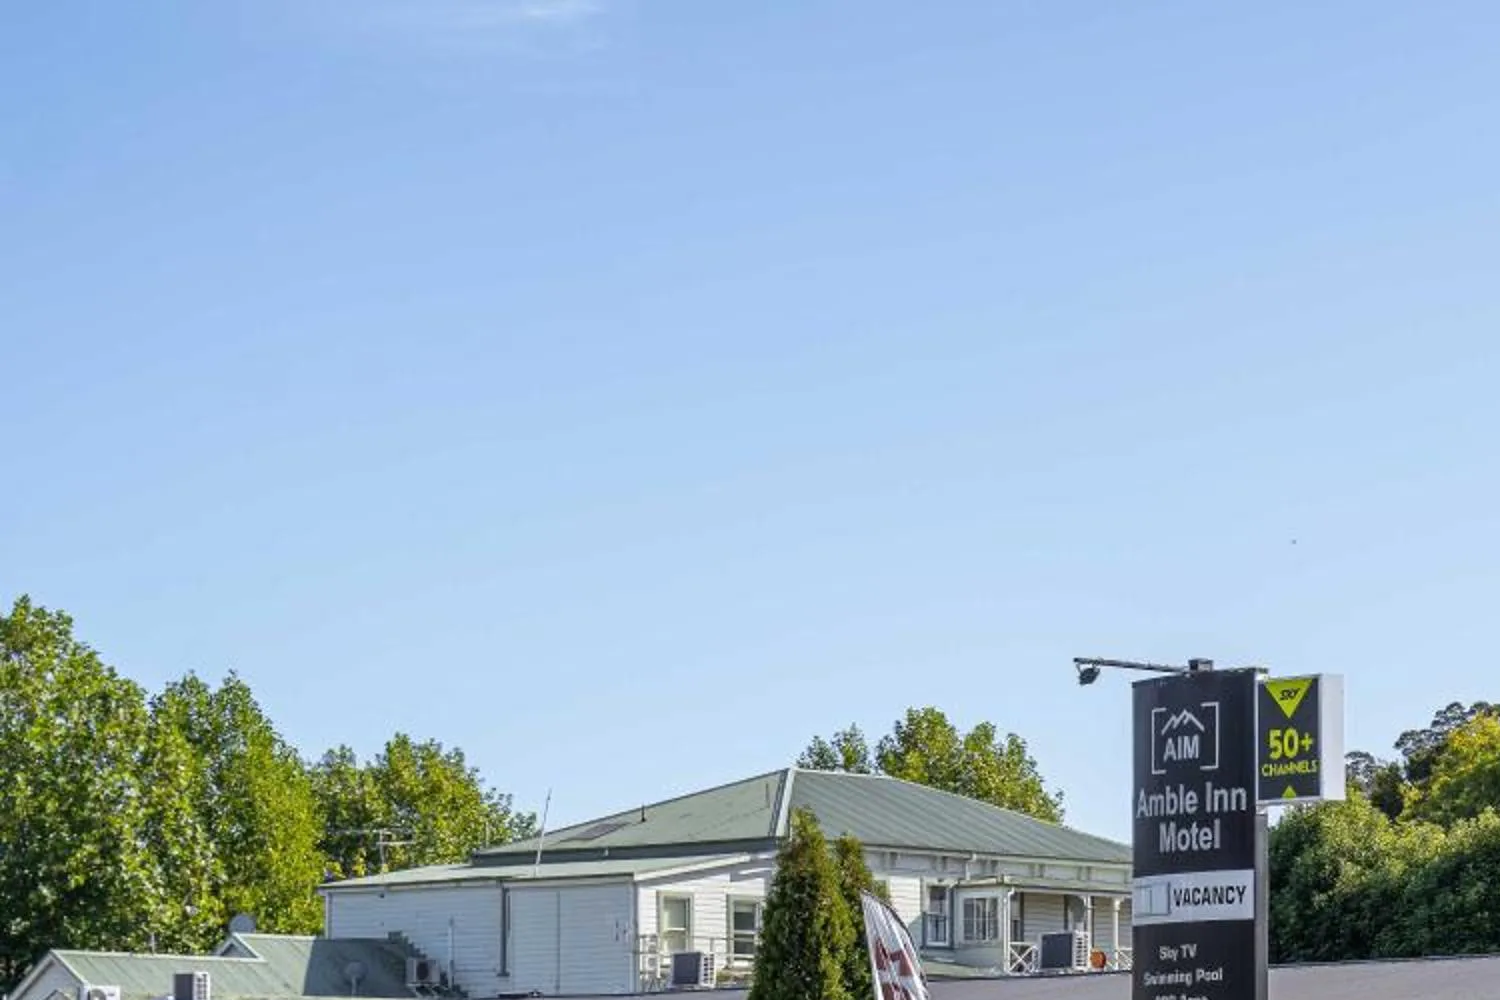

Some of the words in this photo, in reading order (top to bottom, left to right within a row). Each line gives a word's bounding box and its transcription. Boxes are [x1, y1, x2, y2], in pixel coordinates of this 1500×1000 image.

[1164, 735, 1199, 761] AIM
[1269, 728, 1313, 759] 50+
[1262, 760, 1317, 777] CHANNELS
[1136, 784, 1199, 818] Amble
[1205, 782, 1247, 812] Inn
[1159, 819, 1221, 853] Motel
[1173, 885, 1247, 907] VACANCY
[1159, 945, 1179, 961] Sky
[1180, 944, 1197, 959] TV
[1143, 969, 1193, 987] Swimming
[1195, 967, 1223, 981] Pool
